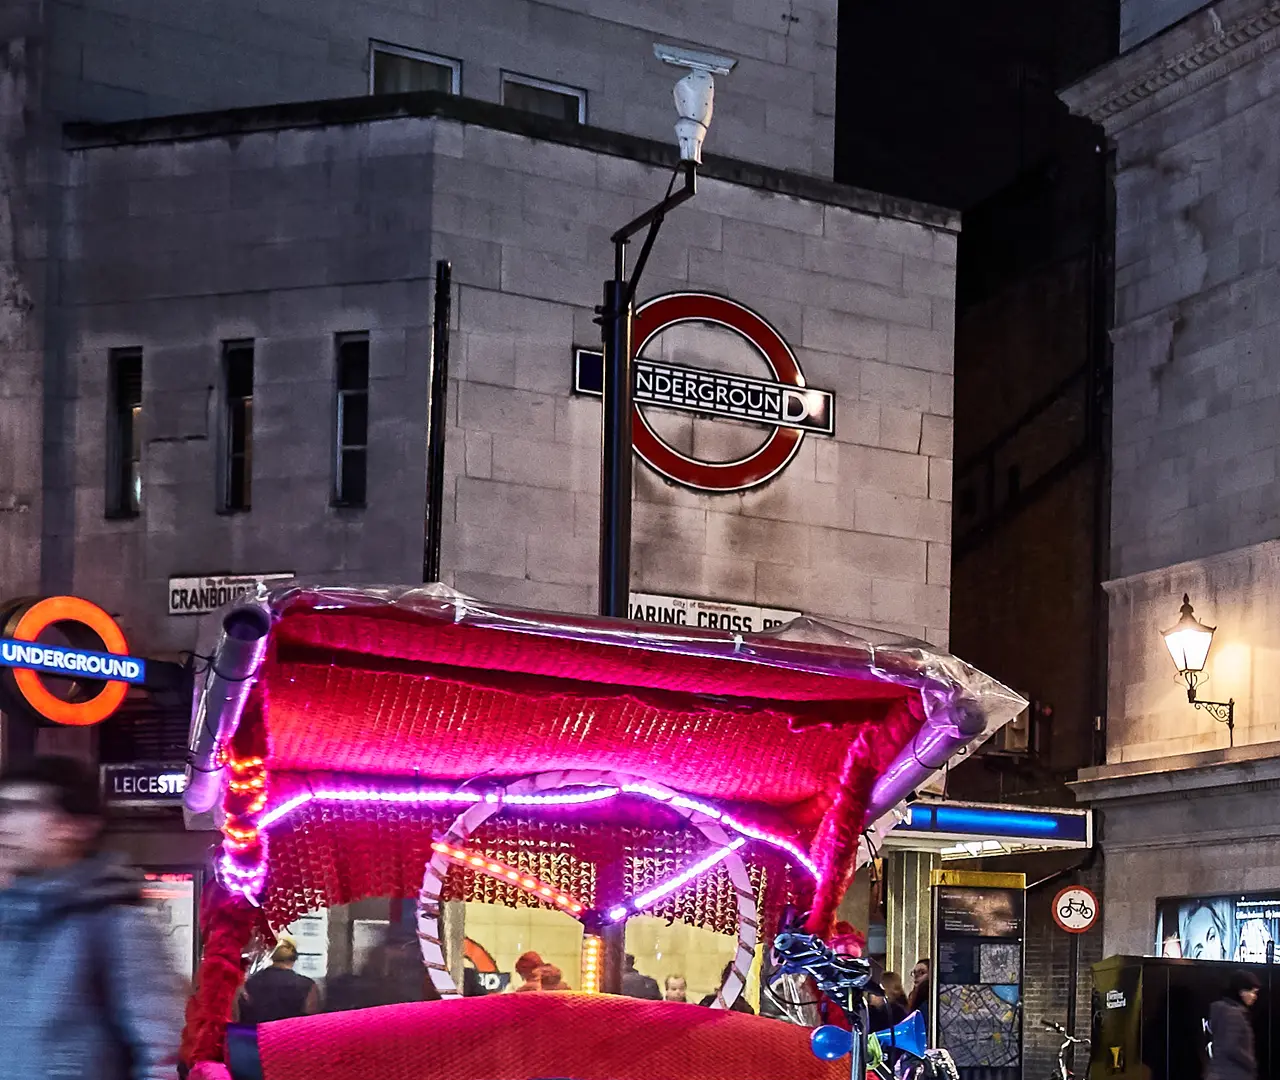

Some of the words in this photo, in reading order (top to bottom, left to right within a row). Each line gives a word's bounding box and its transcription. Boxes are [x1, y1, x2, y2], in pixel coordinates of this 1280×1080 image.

[636, 371, 809, 423] NDERGROUND
[698, 611, 752, 632] CROSS
[2, 643, 140, 678] UNDERGROUND
[114, 774, 187, 794] LEICESTE
